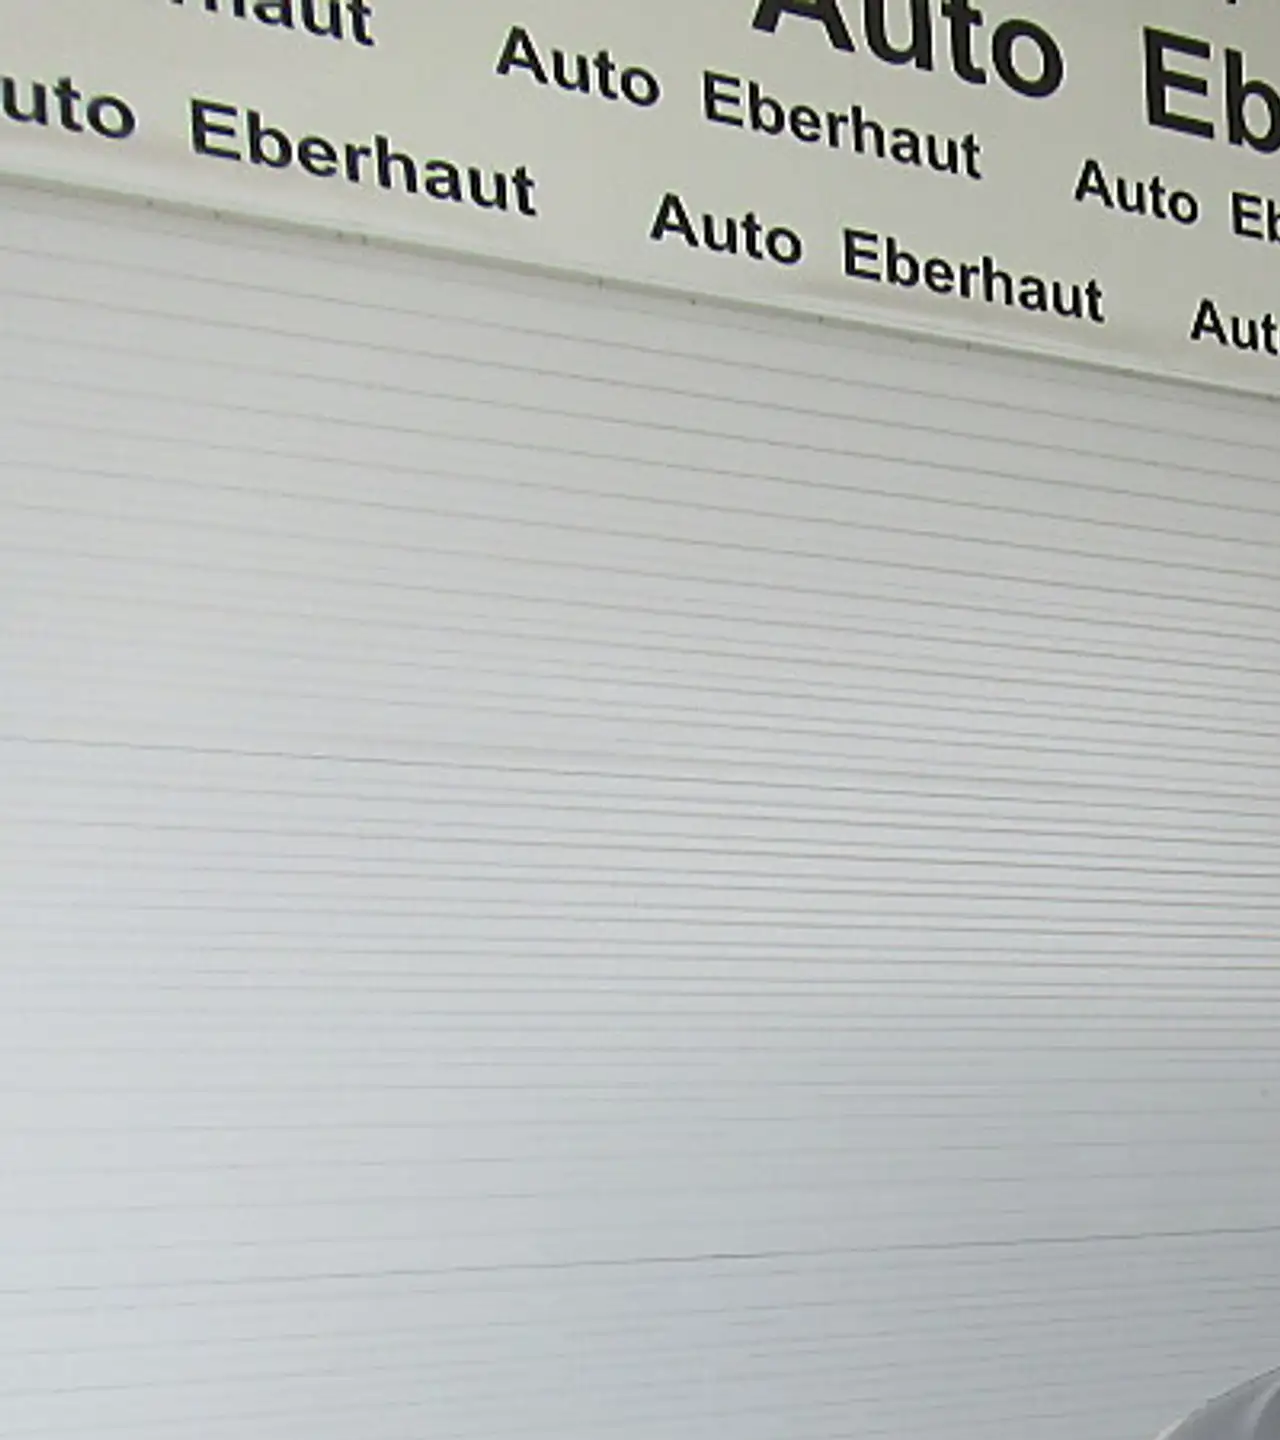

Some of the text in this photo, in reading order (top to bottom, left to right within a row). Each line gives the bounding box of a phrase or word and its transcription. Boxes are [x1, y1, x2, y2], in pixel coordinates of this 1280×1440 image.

[0, 76, 537, 216] uto Eberhaut
[496, 26, 981, 180] Auto Eberhaut
[650, 193, 1104, 323] Auto Eberhaut
[1075, 159, 1198, 225] Auto
